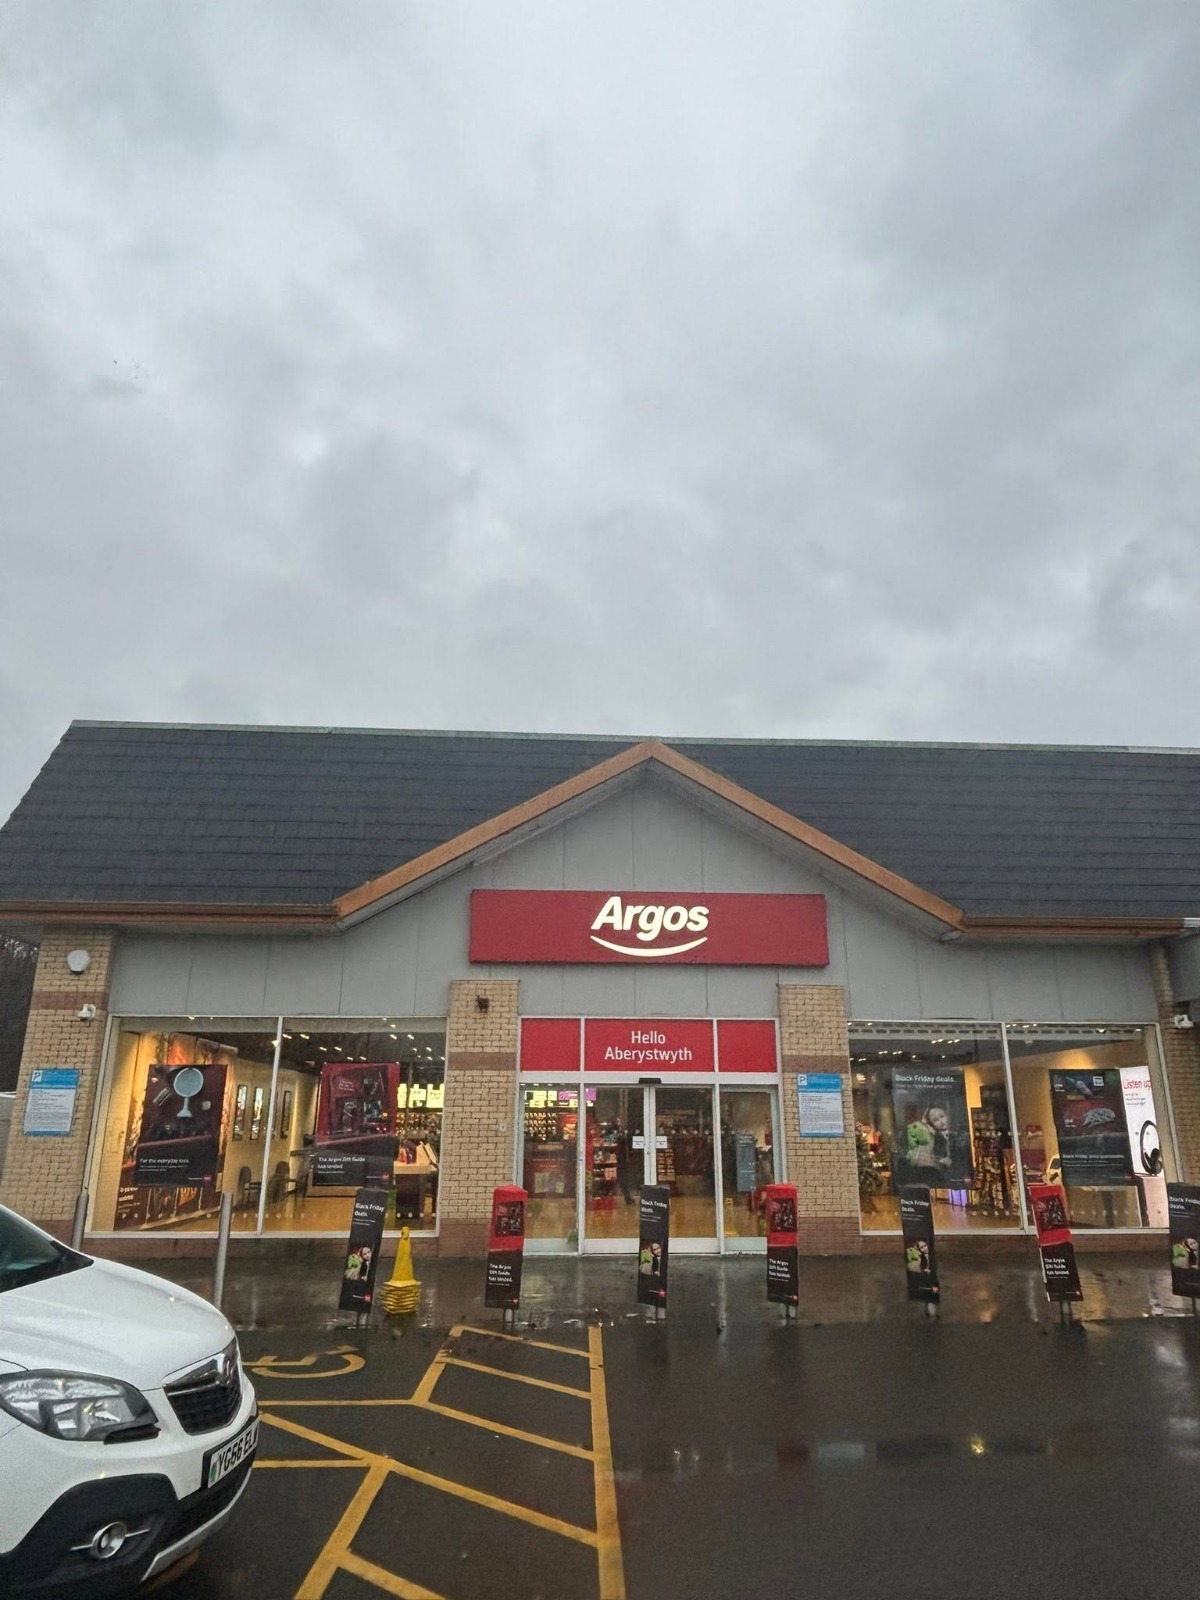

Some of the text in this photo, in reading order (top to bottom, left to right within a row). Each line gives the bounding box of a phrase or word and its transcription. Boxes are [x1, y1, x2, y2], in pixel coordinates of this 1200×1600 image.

[590, 895, 710, 942] Argos
[631, 1030, 666, 1045] Hello
[604, 1046, 693, 1064] Aberystwyth
[914, 1074, 935, 1084] Friday
[1124, 1079, 1143, 1090] Listen
[355, 1202, 385, 1213] Black Friday
[653, 1200, 668, 1209] Friday
